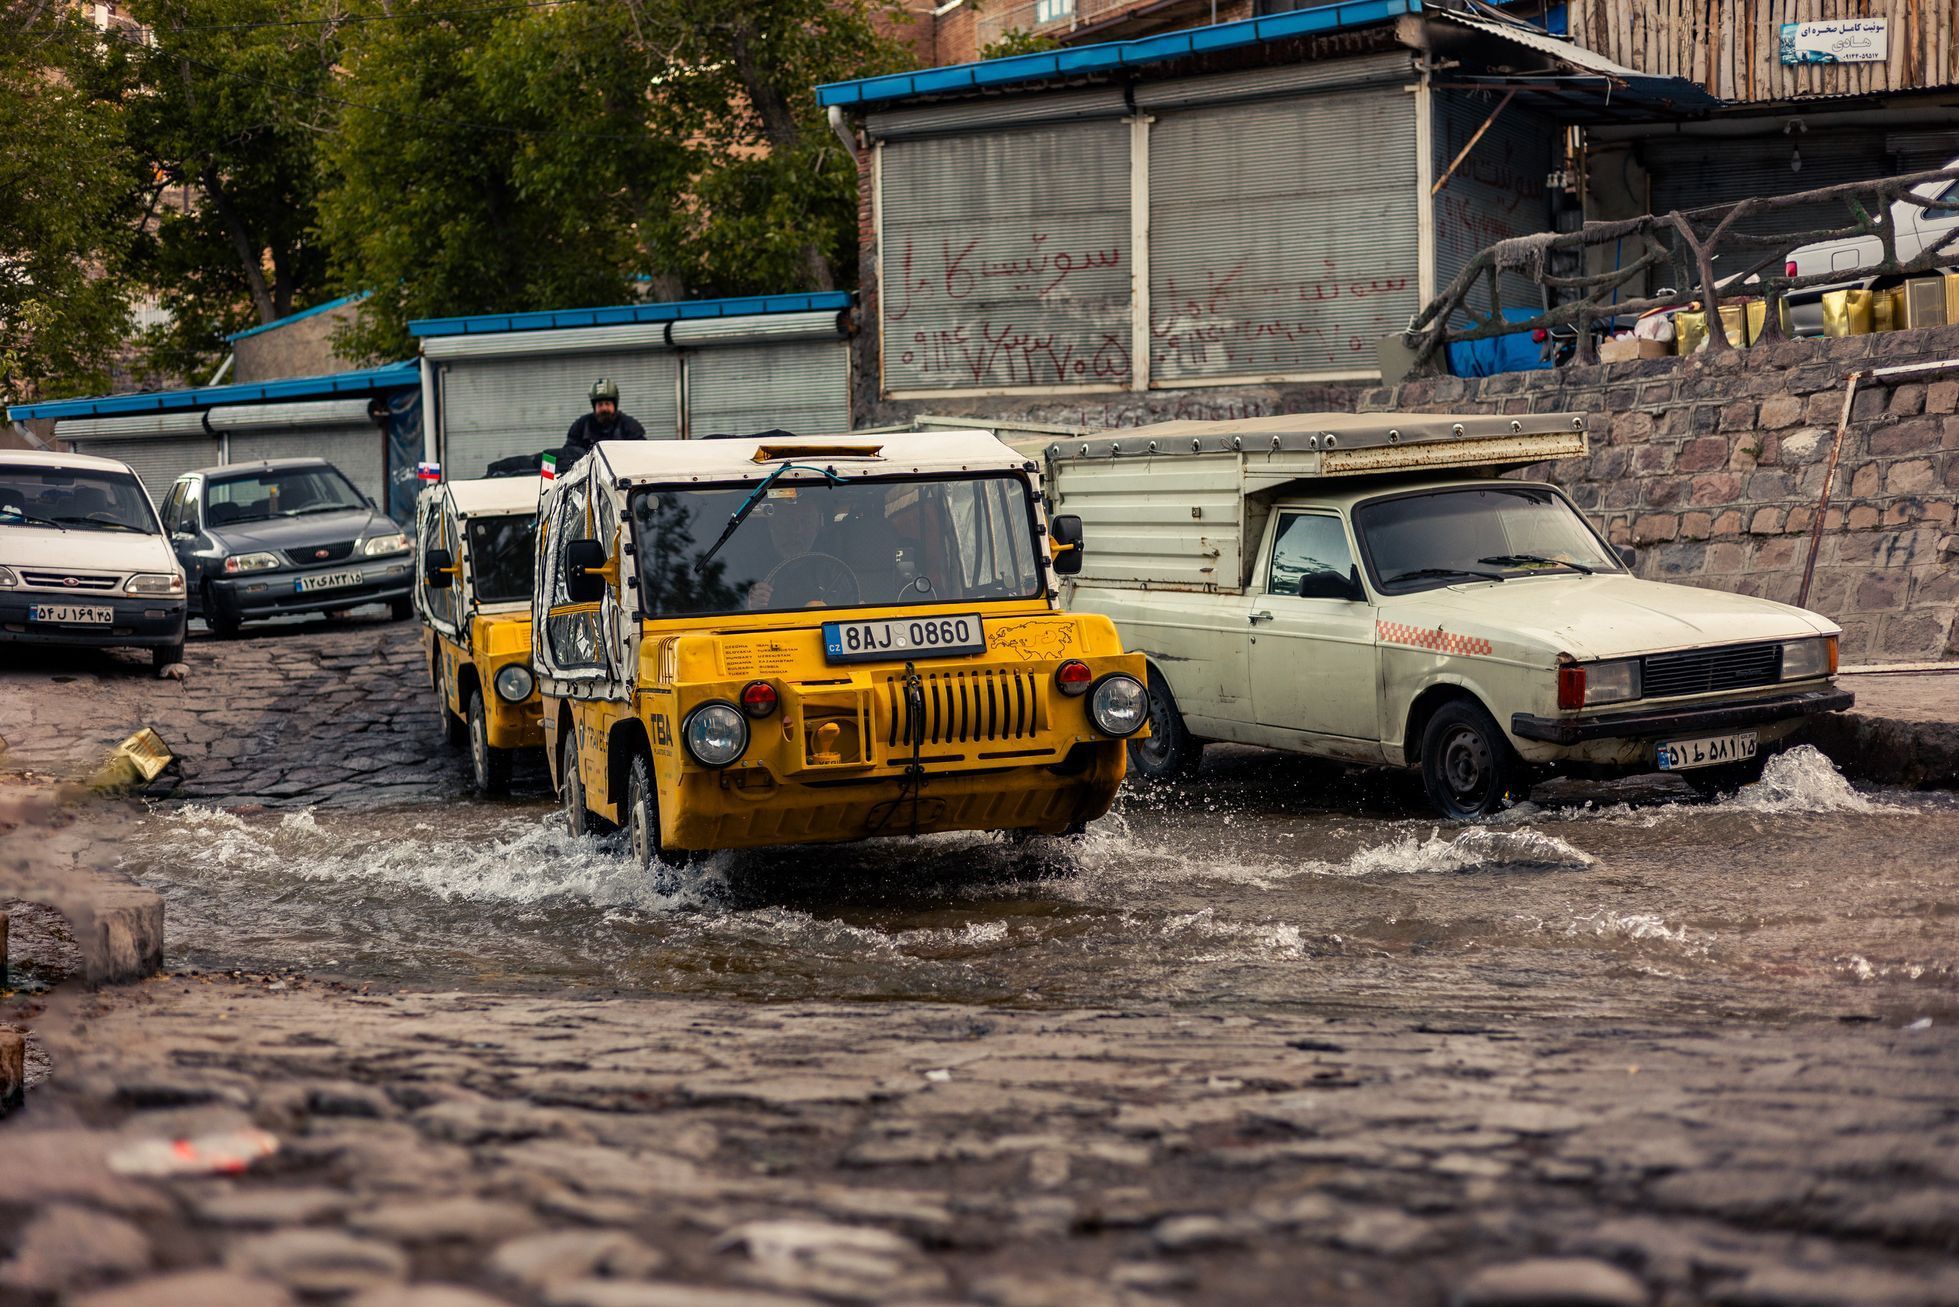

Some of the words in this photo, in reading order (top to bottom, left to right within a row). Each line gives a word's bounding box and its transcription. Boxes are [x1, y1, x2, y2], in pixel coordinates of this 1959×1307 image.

[1839, 23, 1862, 35] کامل
[1832, 36, 1872, 52] هادی
[846, 624, 892, 651] 8AJ
[909, 619, 970, 647] 0860
[829, 644, 841, 652] CZ
[1742, 739, 1755, 756] ۱۵
